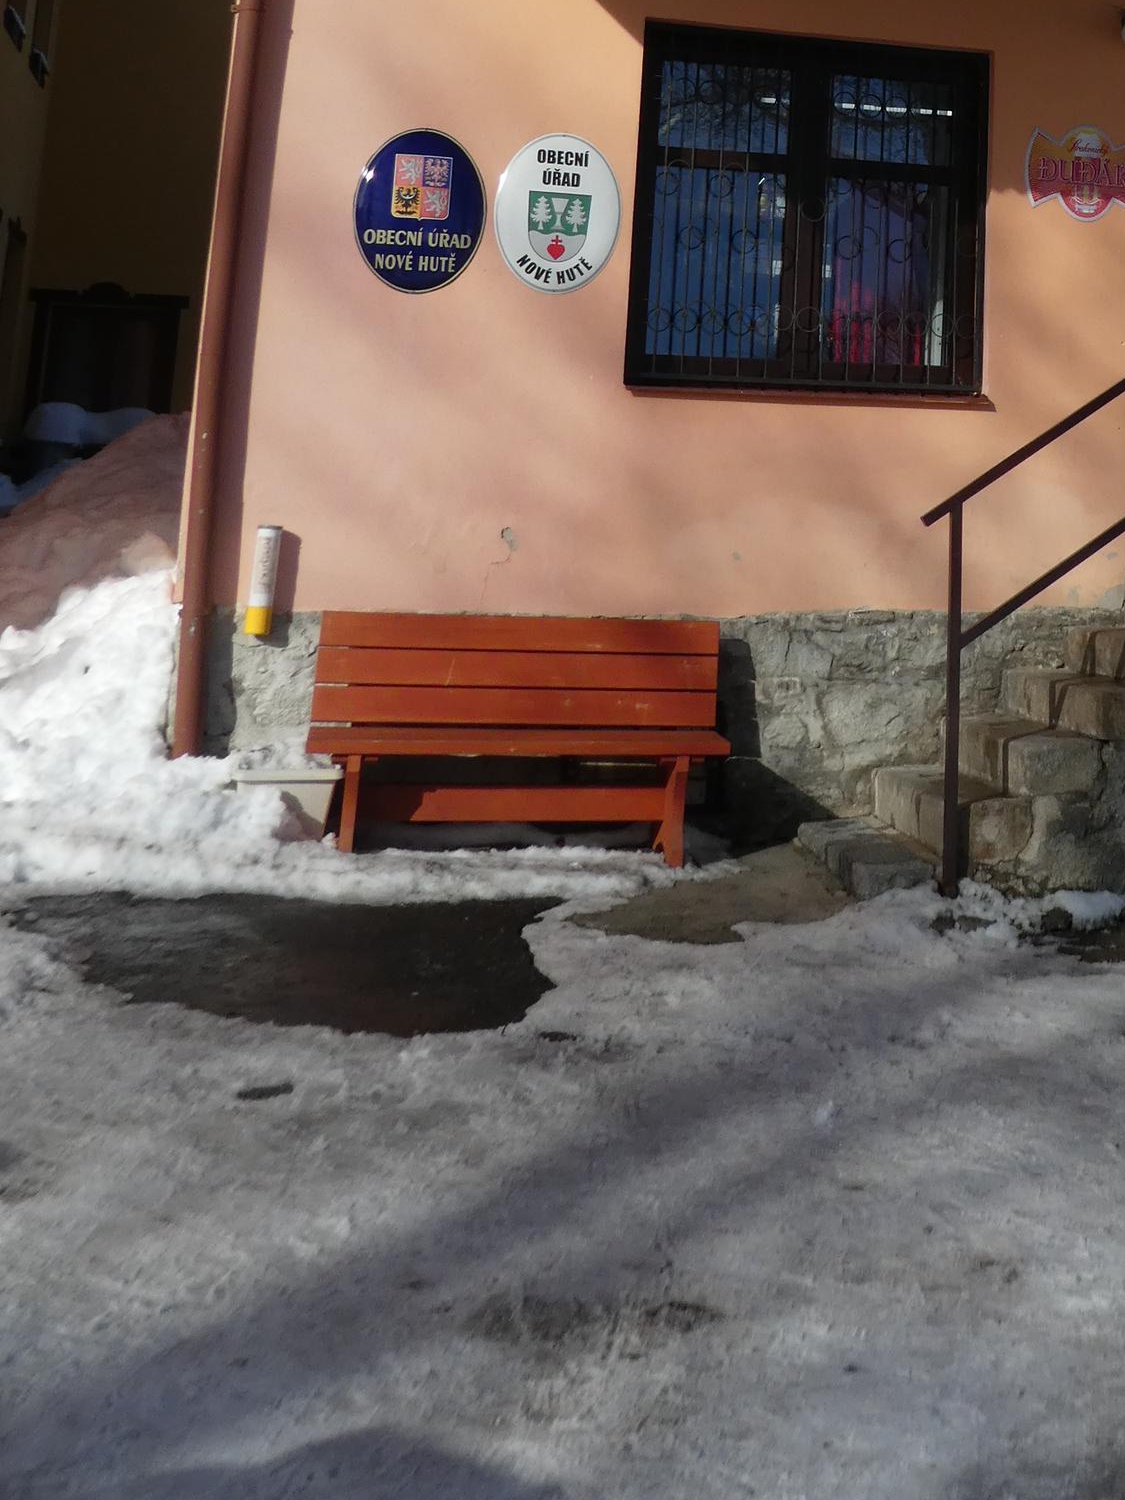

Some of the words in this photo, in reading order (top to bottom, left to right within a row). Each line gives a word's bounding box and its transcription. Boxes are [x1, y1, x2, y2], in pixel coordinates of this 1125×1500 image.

[537, 149, 589, 167] OBECNÍ
[542, 168, 581, 188] ÚŘAD
[363, 227, 424, 247] OBECNÍ
[427, 228, 472, 250] ÚŘAD
[374, 252, 413, 272] NOVÉ
[417, 253, 457, 274] HUTĚ
[516, 254, 552, 285] NOVÉ
[556, 256, 593, 285] HUTĚ
